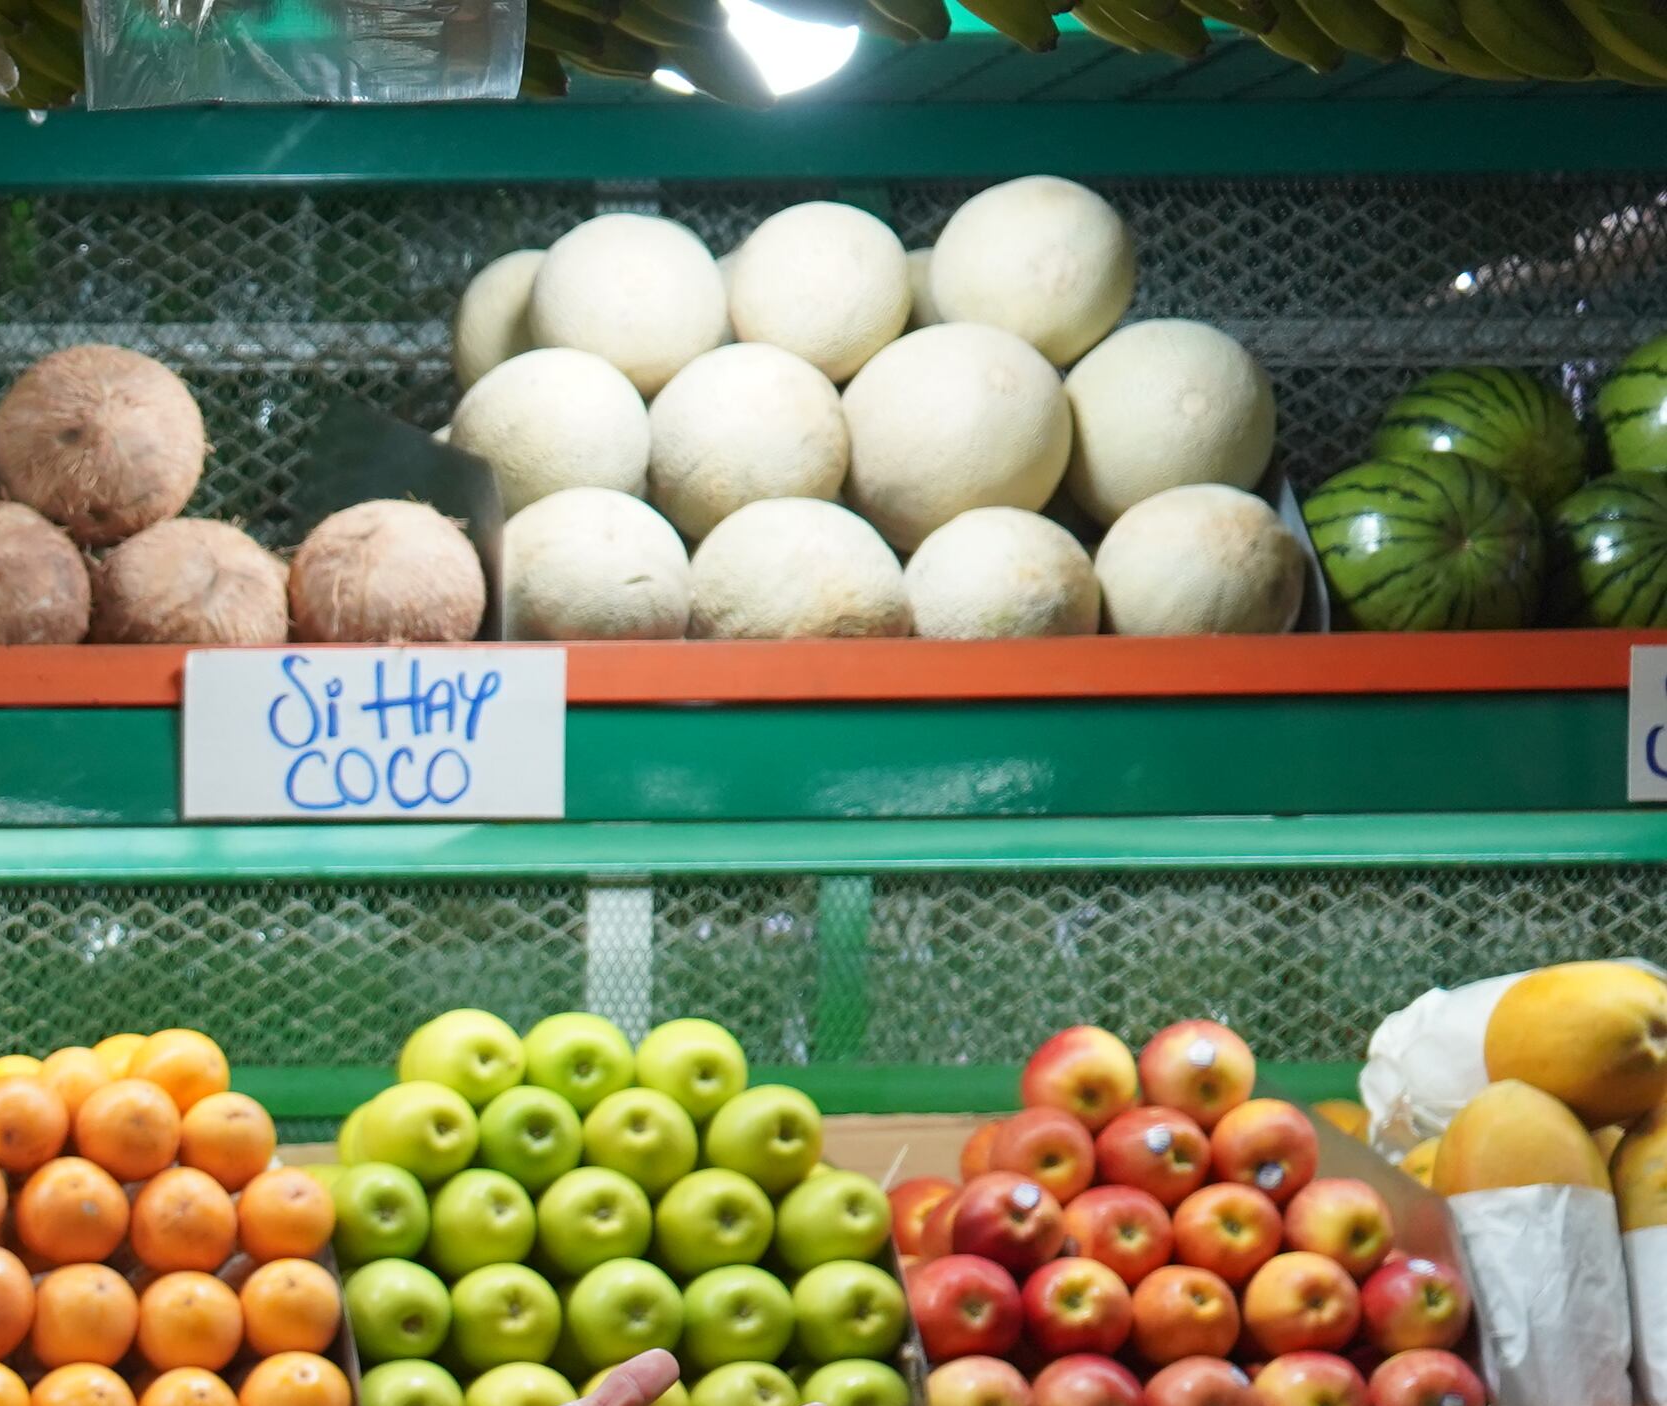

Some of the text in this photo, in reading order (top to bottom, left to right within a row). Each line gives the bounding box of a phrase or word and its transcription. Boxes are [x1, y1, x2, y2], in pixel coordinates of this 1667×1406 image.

[268, 654, 501, 748] Si HAY
[285, 747, 471, 811] COCO
